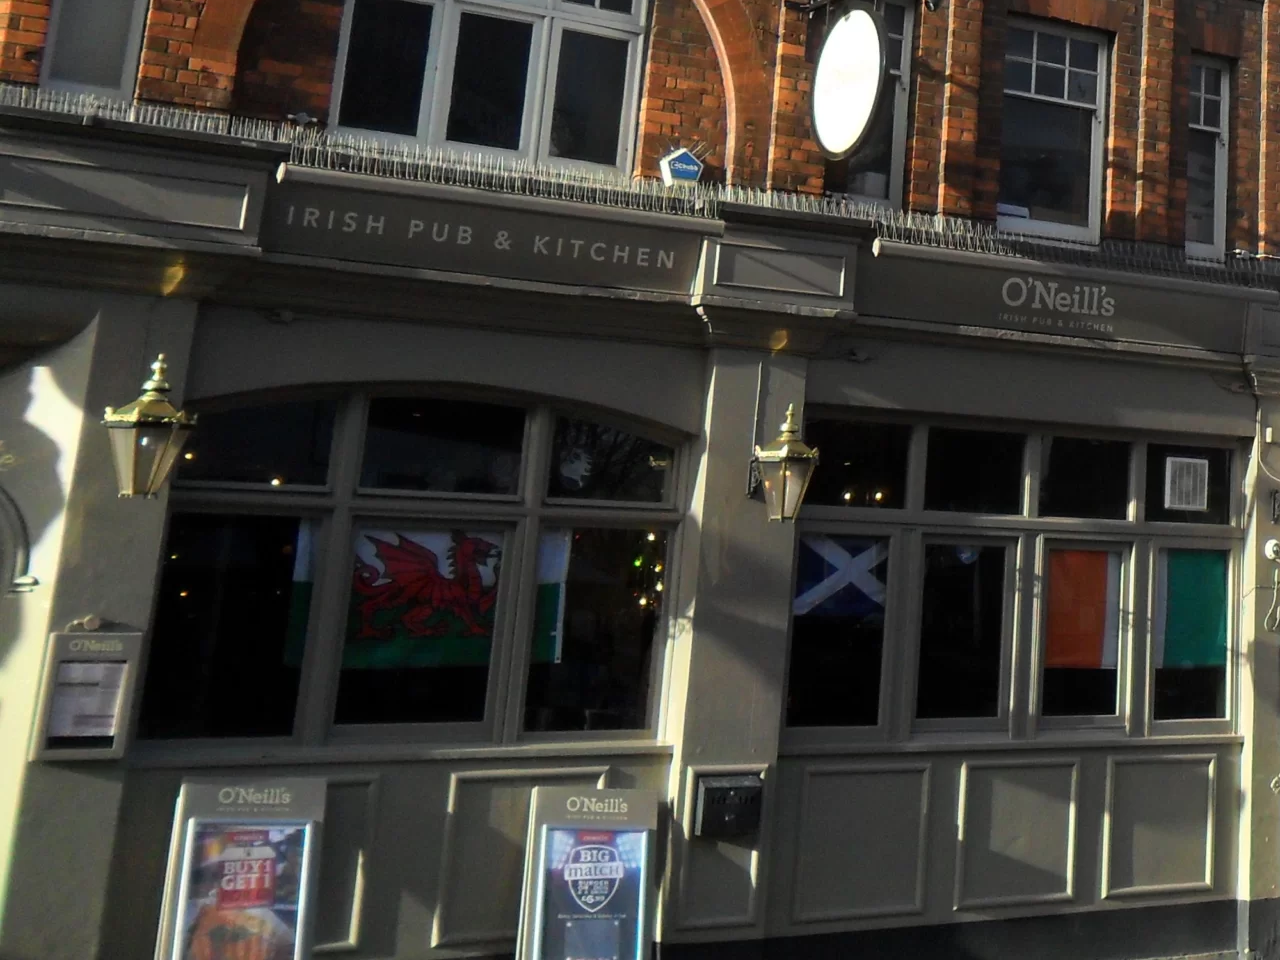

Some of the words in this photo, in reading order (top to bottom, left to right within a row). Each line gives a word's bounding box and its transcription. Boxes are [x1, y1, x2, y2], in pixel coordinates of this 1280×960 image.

[287, 205, 385, 235] IRISH
[408, 219, 473, 245] PUB
[494, 230, 512, 250] &
[533, 235, 674, 269] KITCHEN
[1001, 277, 1115, 316] O'Neill's
[998, 313, 1027, 323] IRISH
[1032, 316, 1052, 326] PUB
[1069, 321, 1114, 332] KITCHEN
[219, 787, 291, 804] O'Neill's
[566, 796, 628, 812] O'Neill's
[580, 849, 609, 862] BIG
[224, 860, 262, 874] BUY
[221, 874, 260, 890] GET
